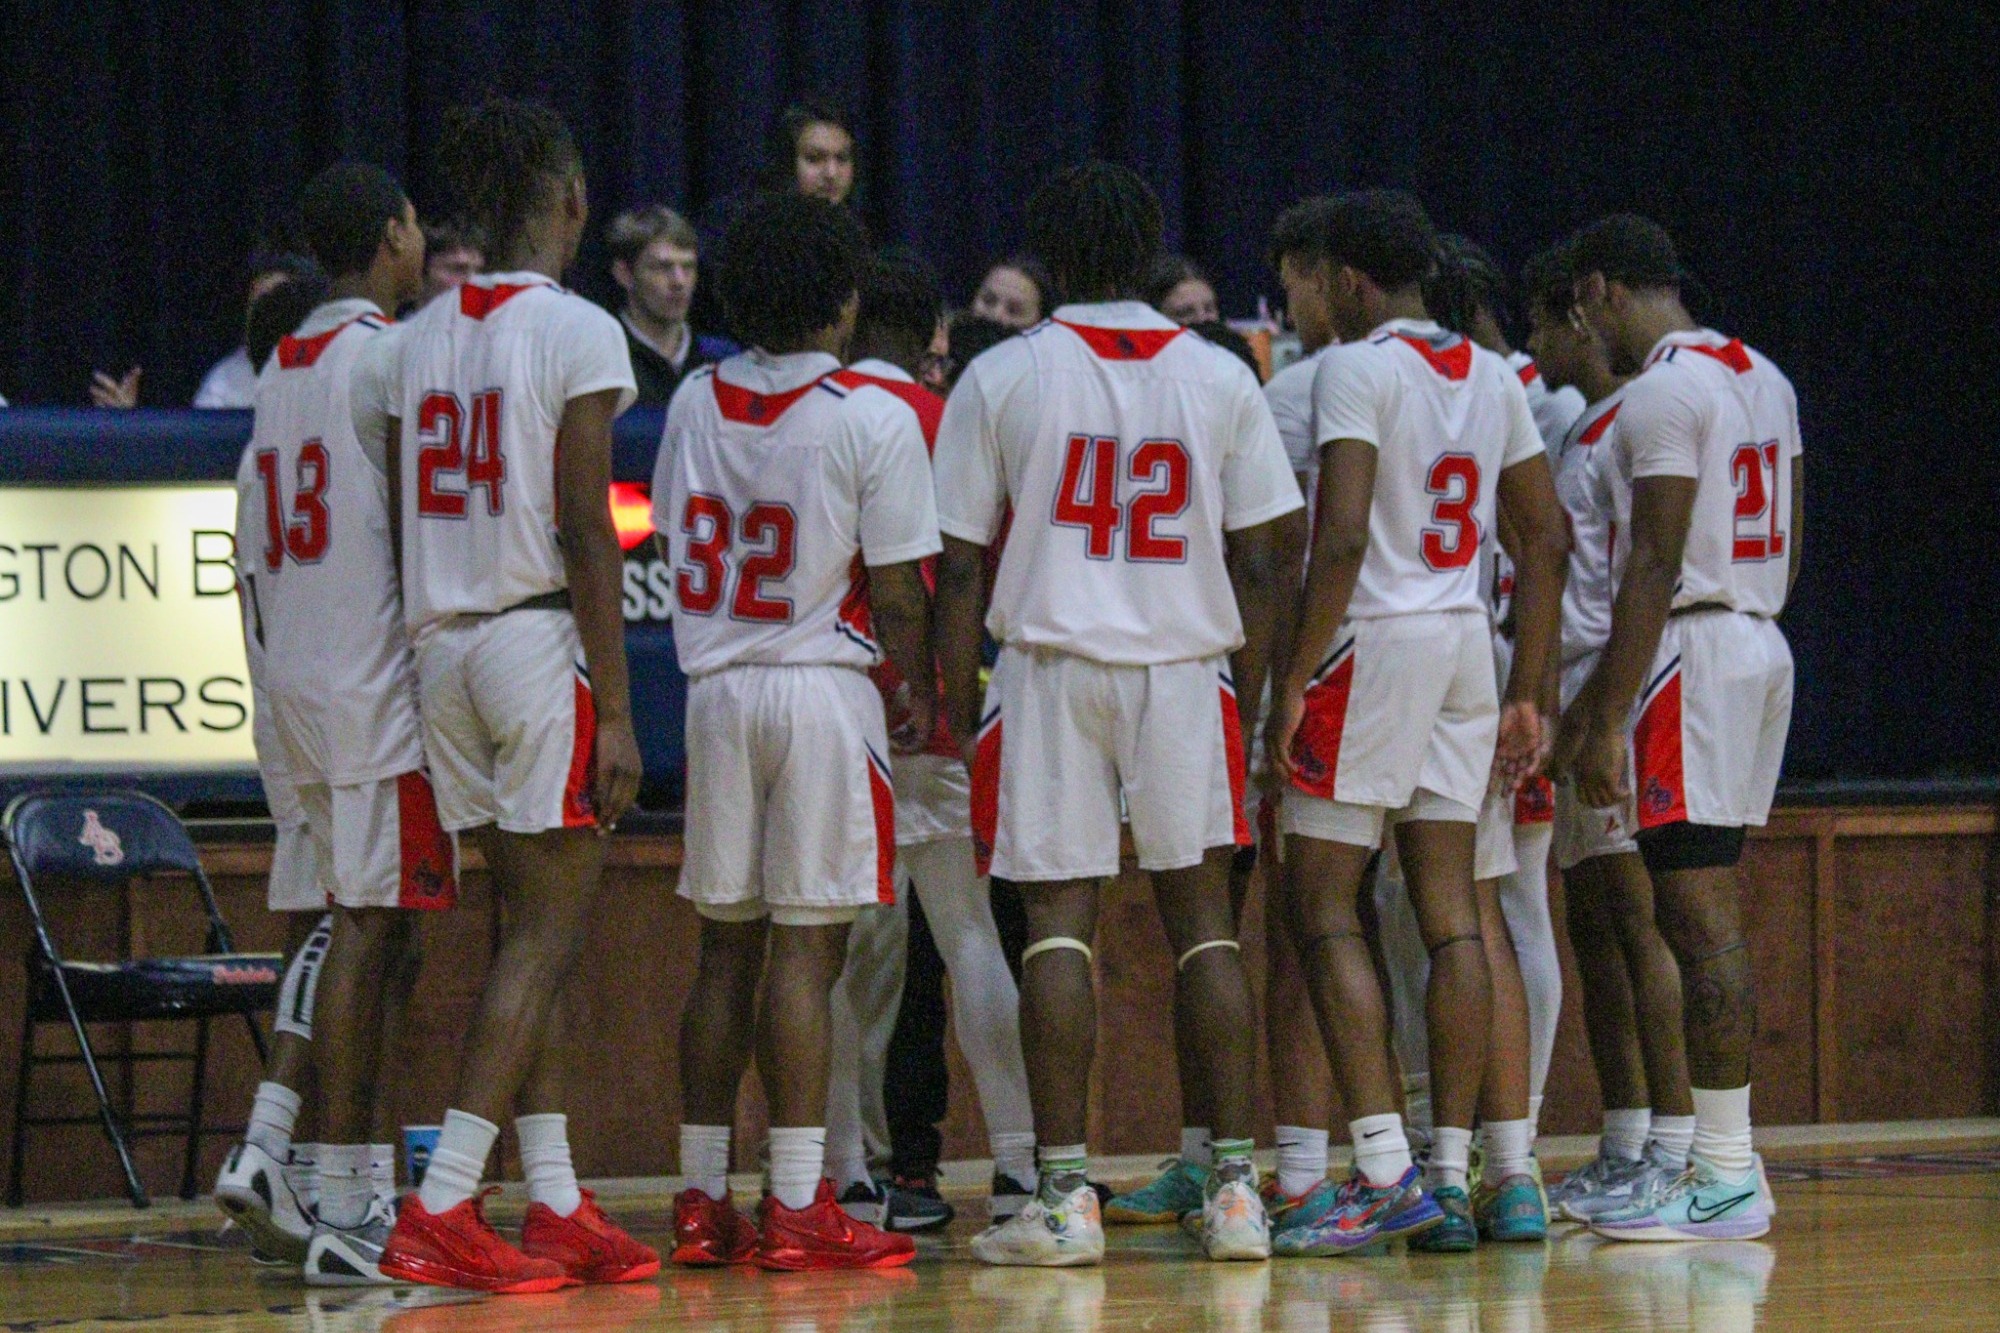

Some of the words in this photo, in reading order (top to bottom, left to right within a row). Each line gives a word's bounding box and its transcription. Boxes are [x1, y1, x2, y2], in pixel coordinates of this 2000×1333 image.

[257, 437, 331, 574] 13
[416, 388, 506, 518] 24
[1050, 433, 1192, 564] 42
[1419, 450, 1484, 573] 3
[1730, 438, 1785, 564] 21
[676, 490, 798, 625] 32
[0, 676, 248, 735] IVERS
